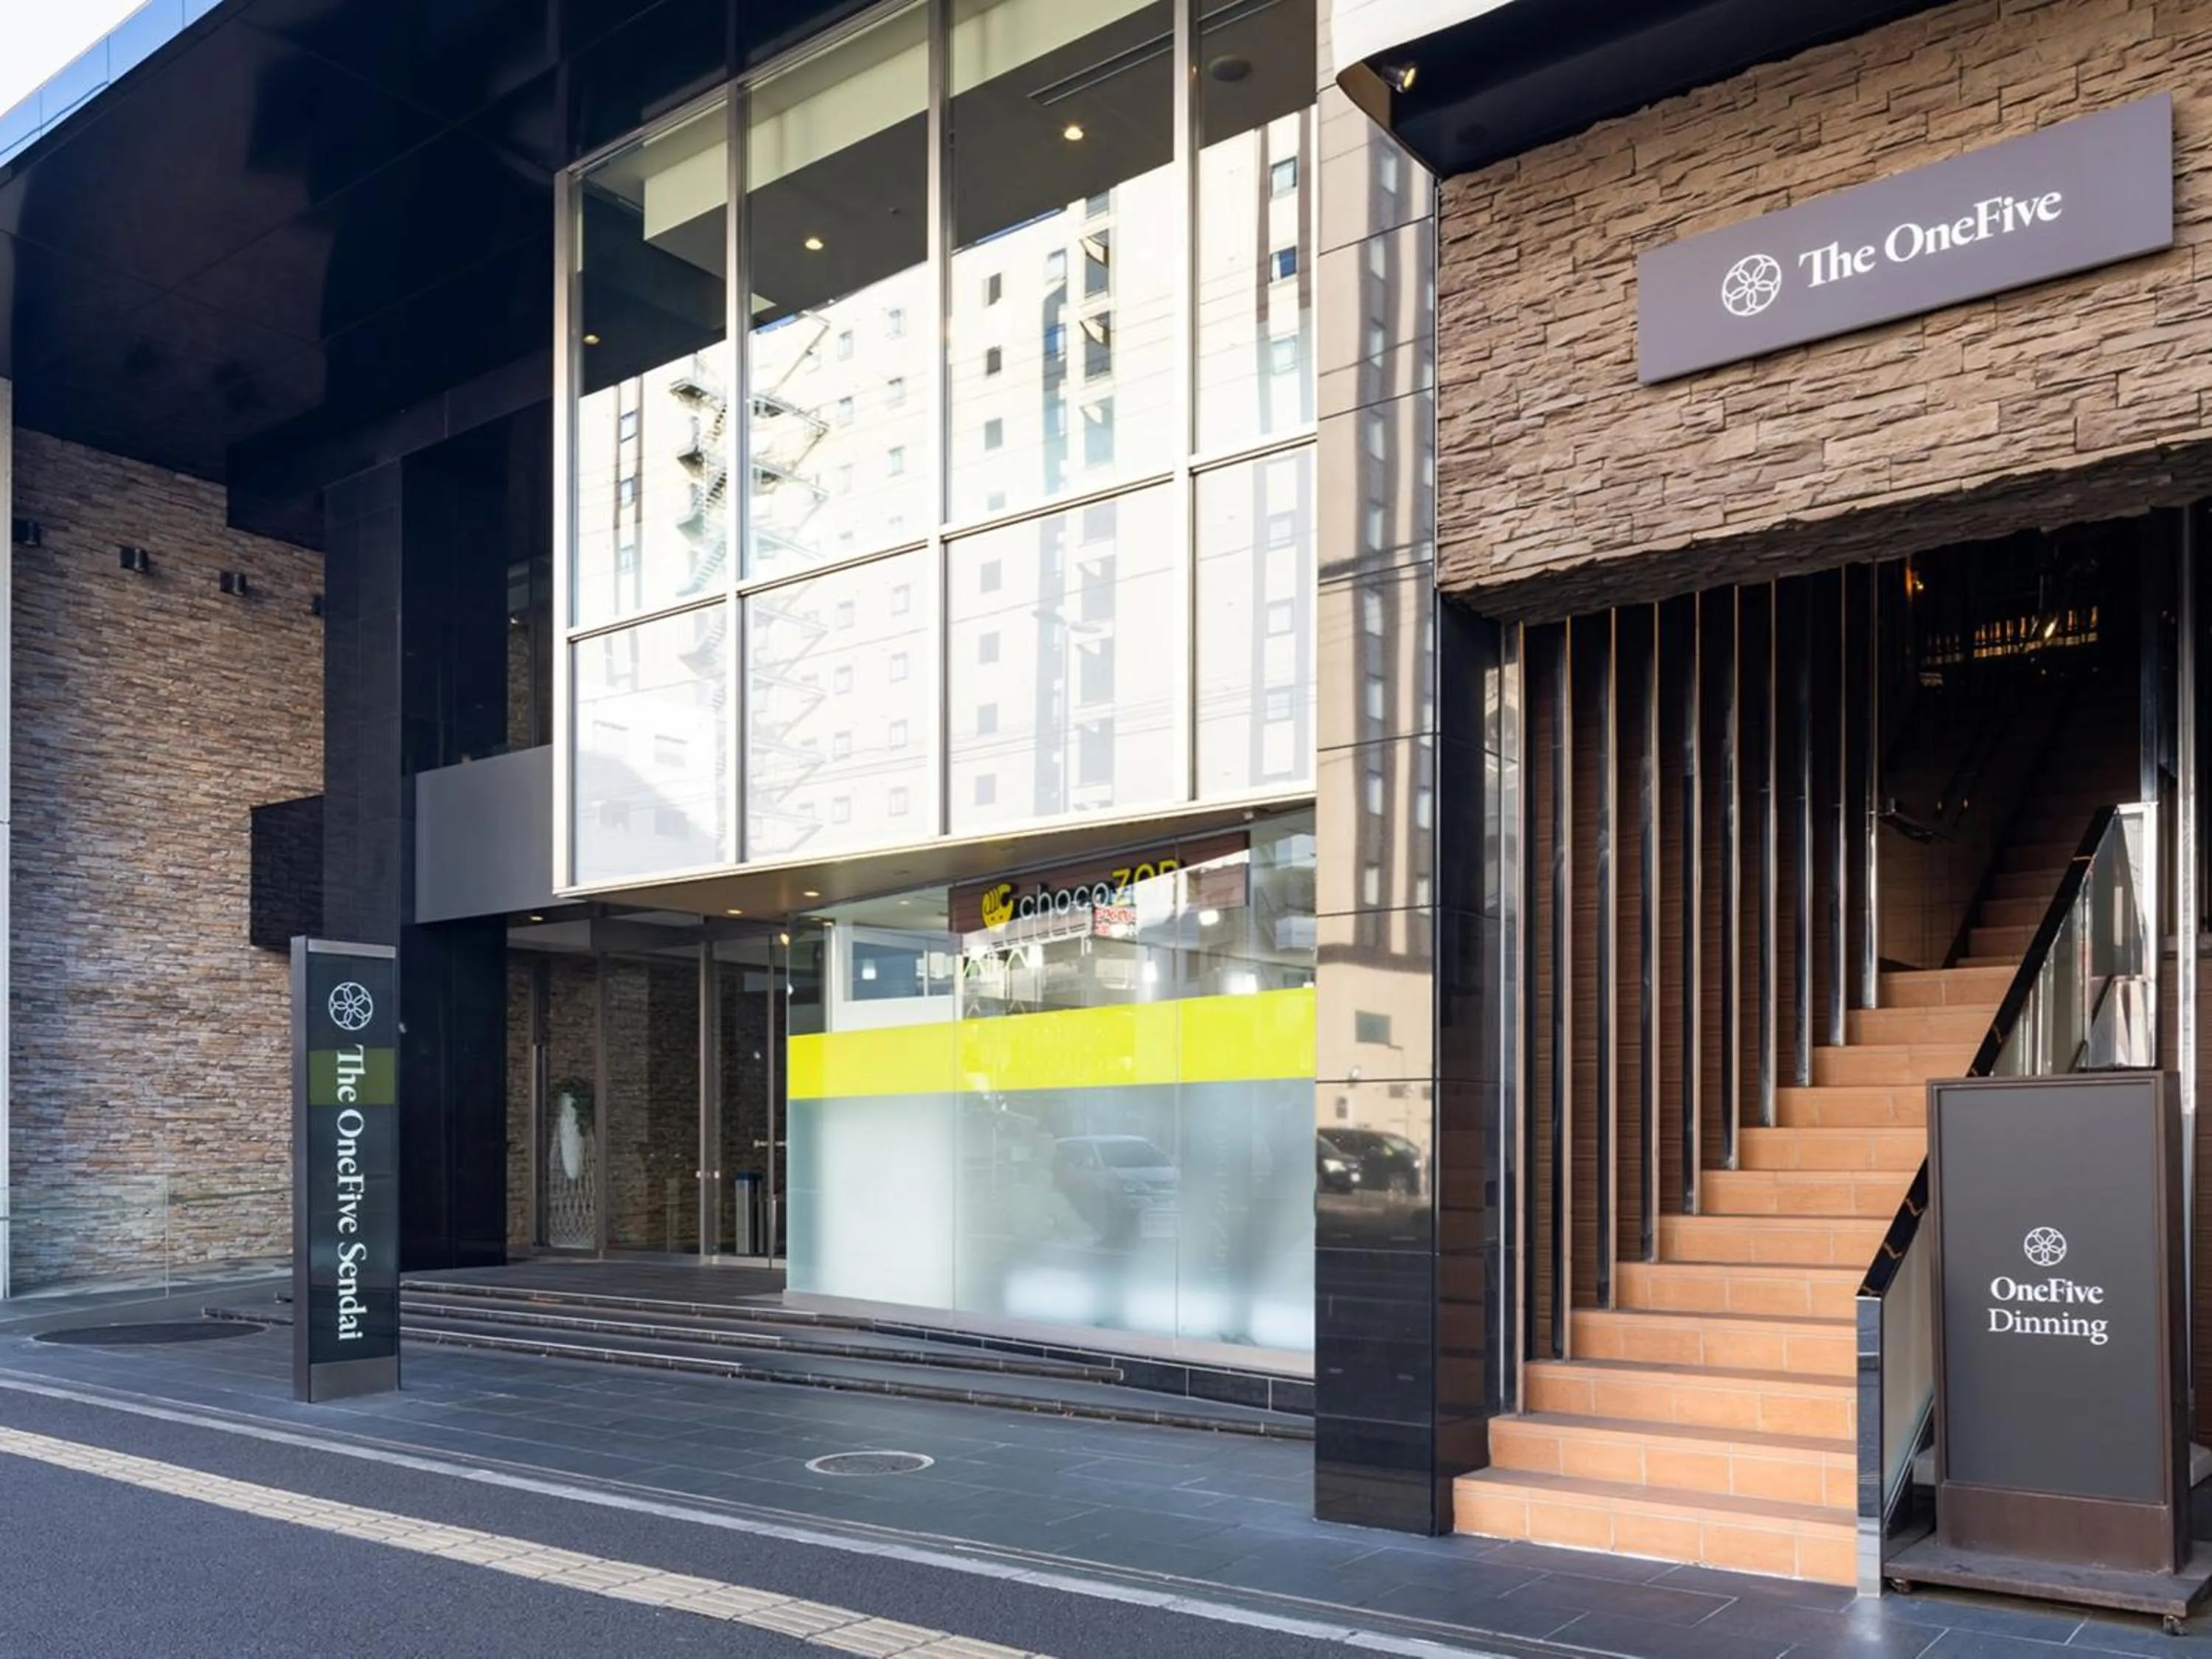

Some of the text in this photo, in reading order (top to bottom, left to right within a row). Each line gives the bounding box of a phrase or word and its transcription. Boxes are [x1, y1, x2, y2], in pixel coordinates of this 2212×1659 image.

[1799, 189, 2063, 288] The OneFive
[336, 1043, 368, 1341] The OneFive Sendai
[1990, 1276, 2104, 1304] OneFive
[1988, 1307, 2110, 1346] Dinning
